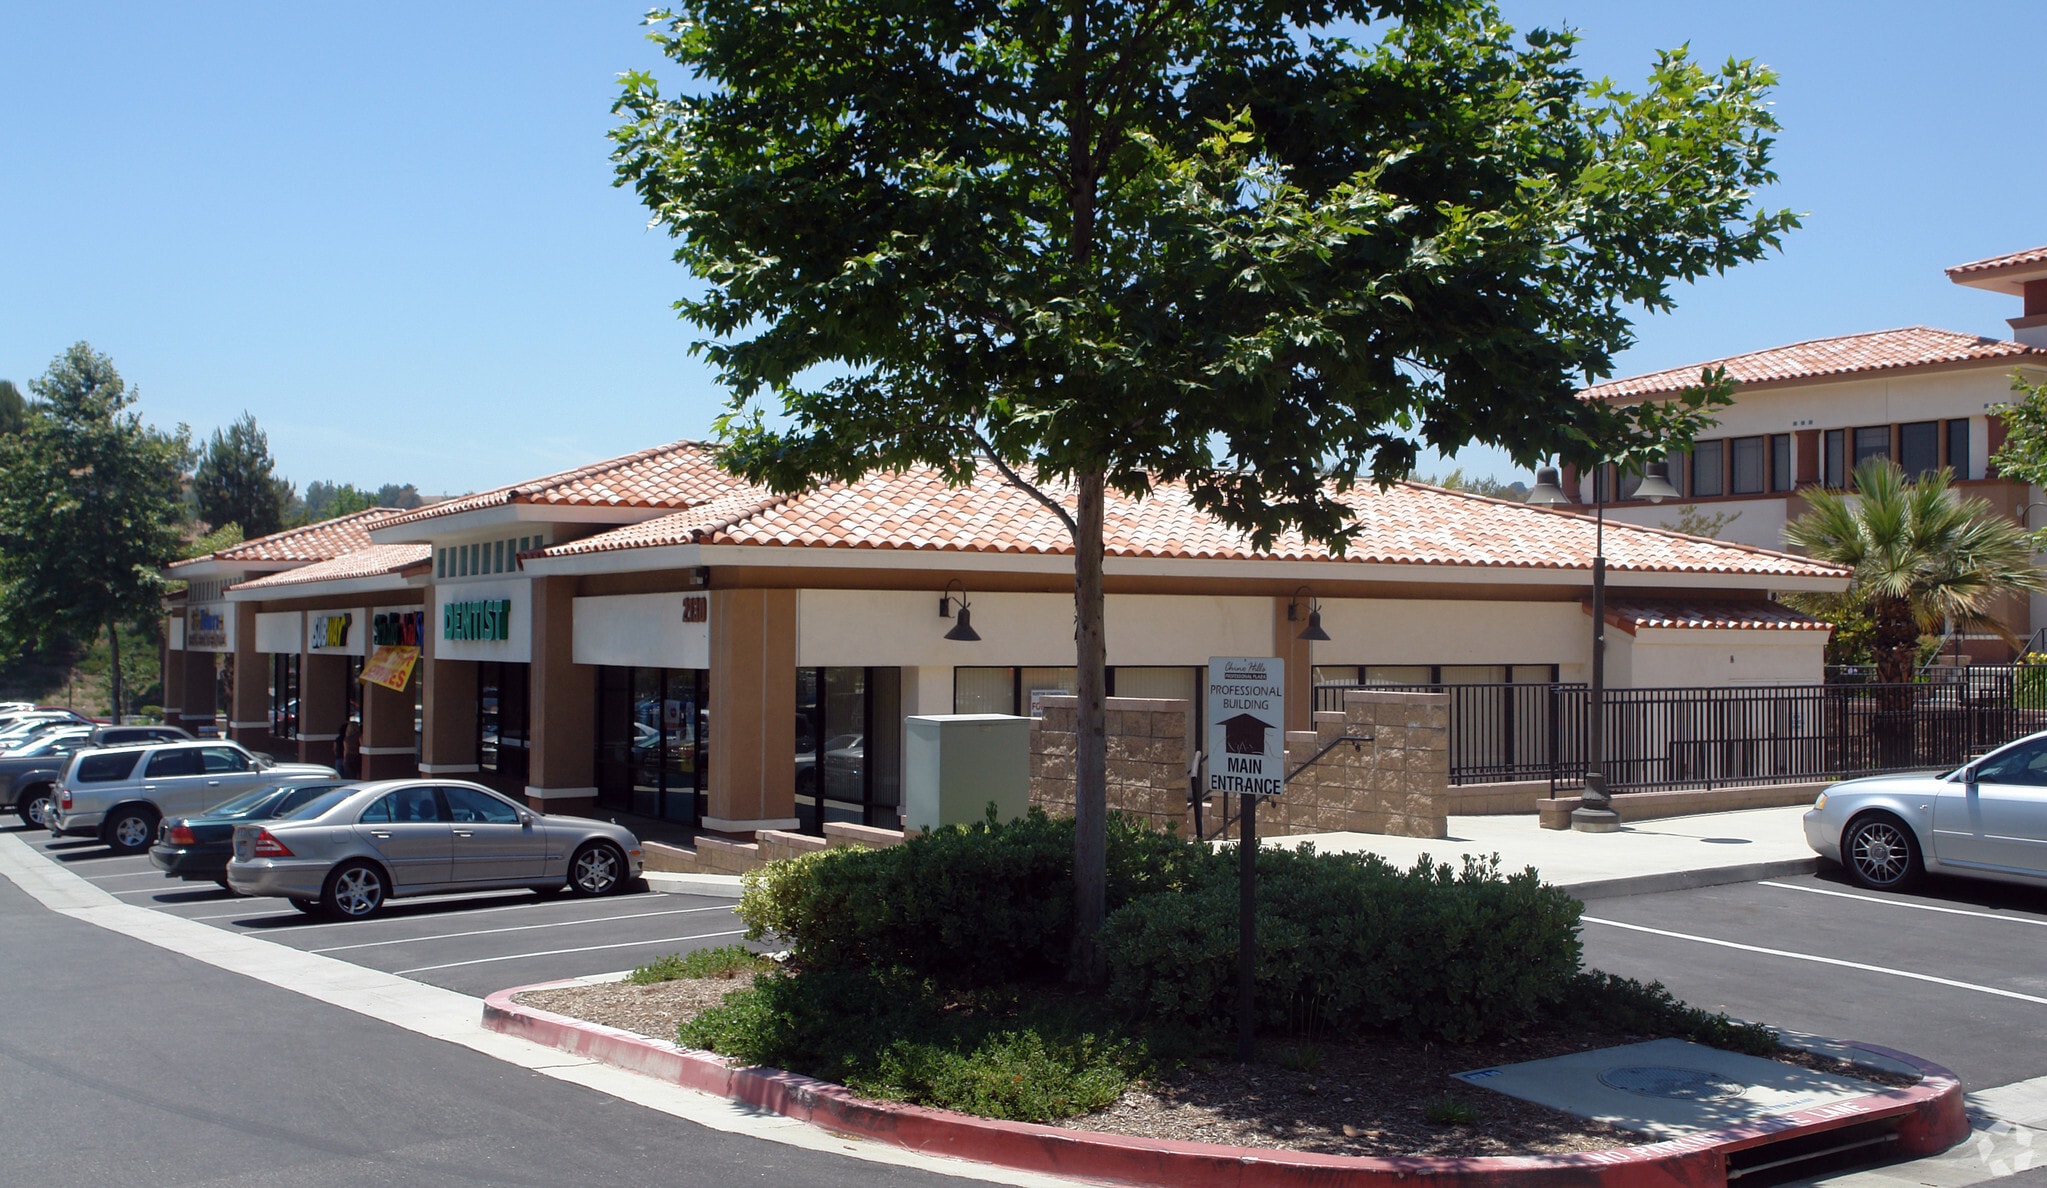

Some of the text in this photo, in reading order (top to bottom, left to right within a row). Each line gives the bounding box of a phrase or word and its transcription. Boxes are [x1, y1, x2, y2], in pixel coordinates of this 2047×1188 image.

[443, 599, 510, 641] DENTIST
[312, 613, 352, 649] SUBWAY
[1248, 662, 1266, 672] Hills
[1210, 684, 1282, 697] PROFESSIONAL
[1223, 699, 1269, 710] BUILDING
[1228, 757, 1262, 774] MAIN
[1211, 774, 1281, 795] ENTRANCE
[1586, 1151, 1630, 1164] NO
[1805, 1101, 1871, 1119] LANE
